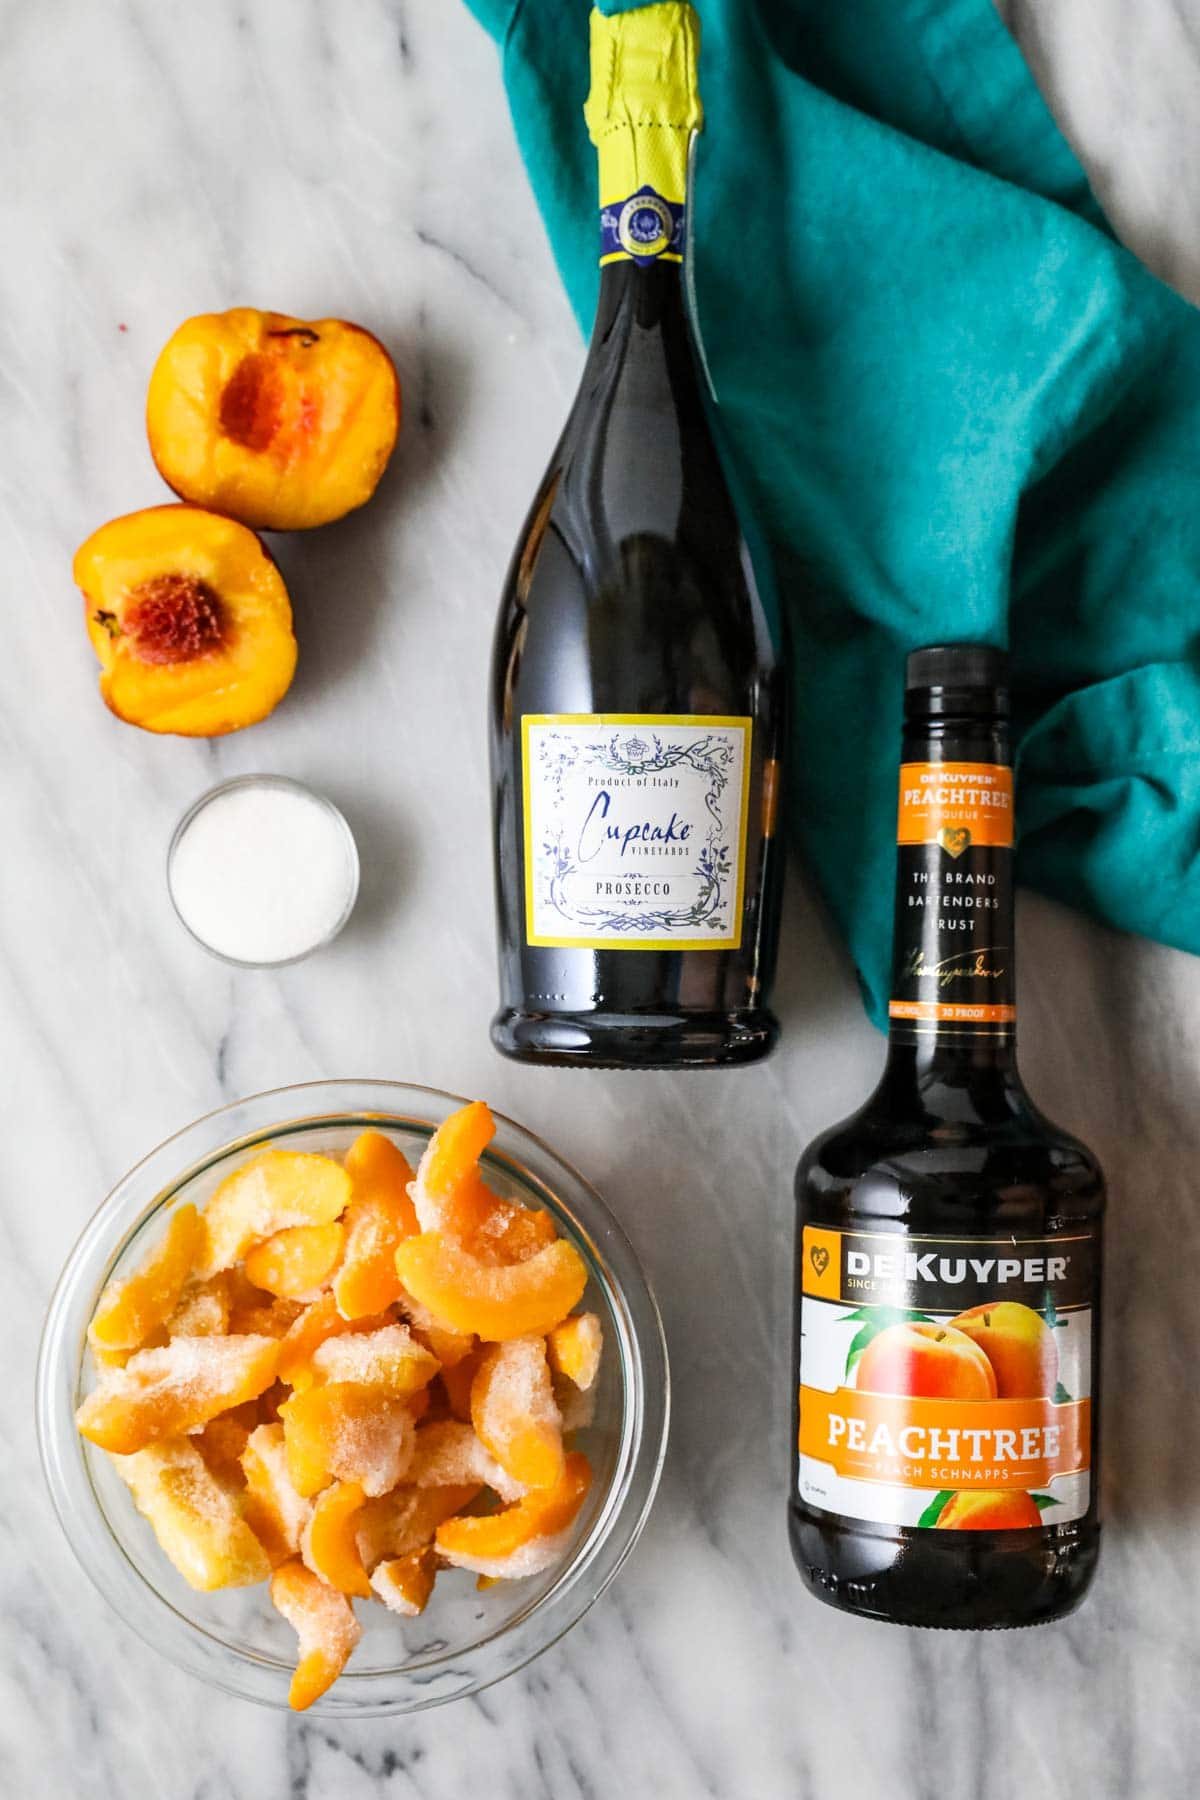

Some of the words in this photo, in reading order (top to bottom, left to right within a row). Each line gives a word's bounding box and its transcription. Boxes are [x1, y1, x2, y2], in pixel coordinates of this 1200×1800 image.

[588, 776, 632, 787] Product
[636, 776, 648, 787] of
[653, 777, 680, 788] Italy
[904, 787, 1009, 808] PEACHTREE
[578, 790, 691, 863] Cupcake
[631, 846, 690, 856] VINEYARDS
[945, 872, 996, 885] BRAND
[596, 881, 671, 896] PROSECCO
[908, 895, 999, 909] BARTENDERS
[827, 1413, 1060, 1463] PEACHTREE
[930, 1467, 1010, 1481] SCHNAPPS
